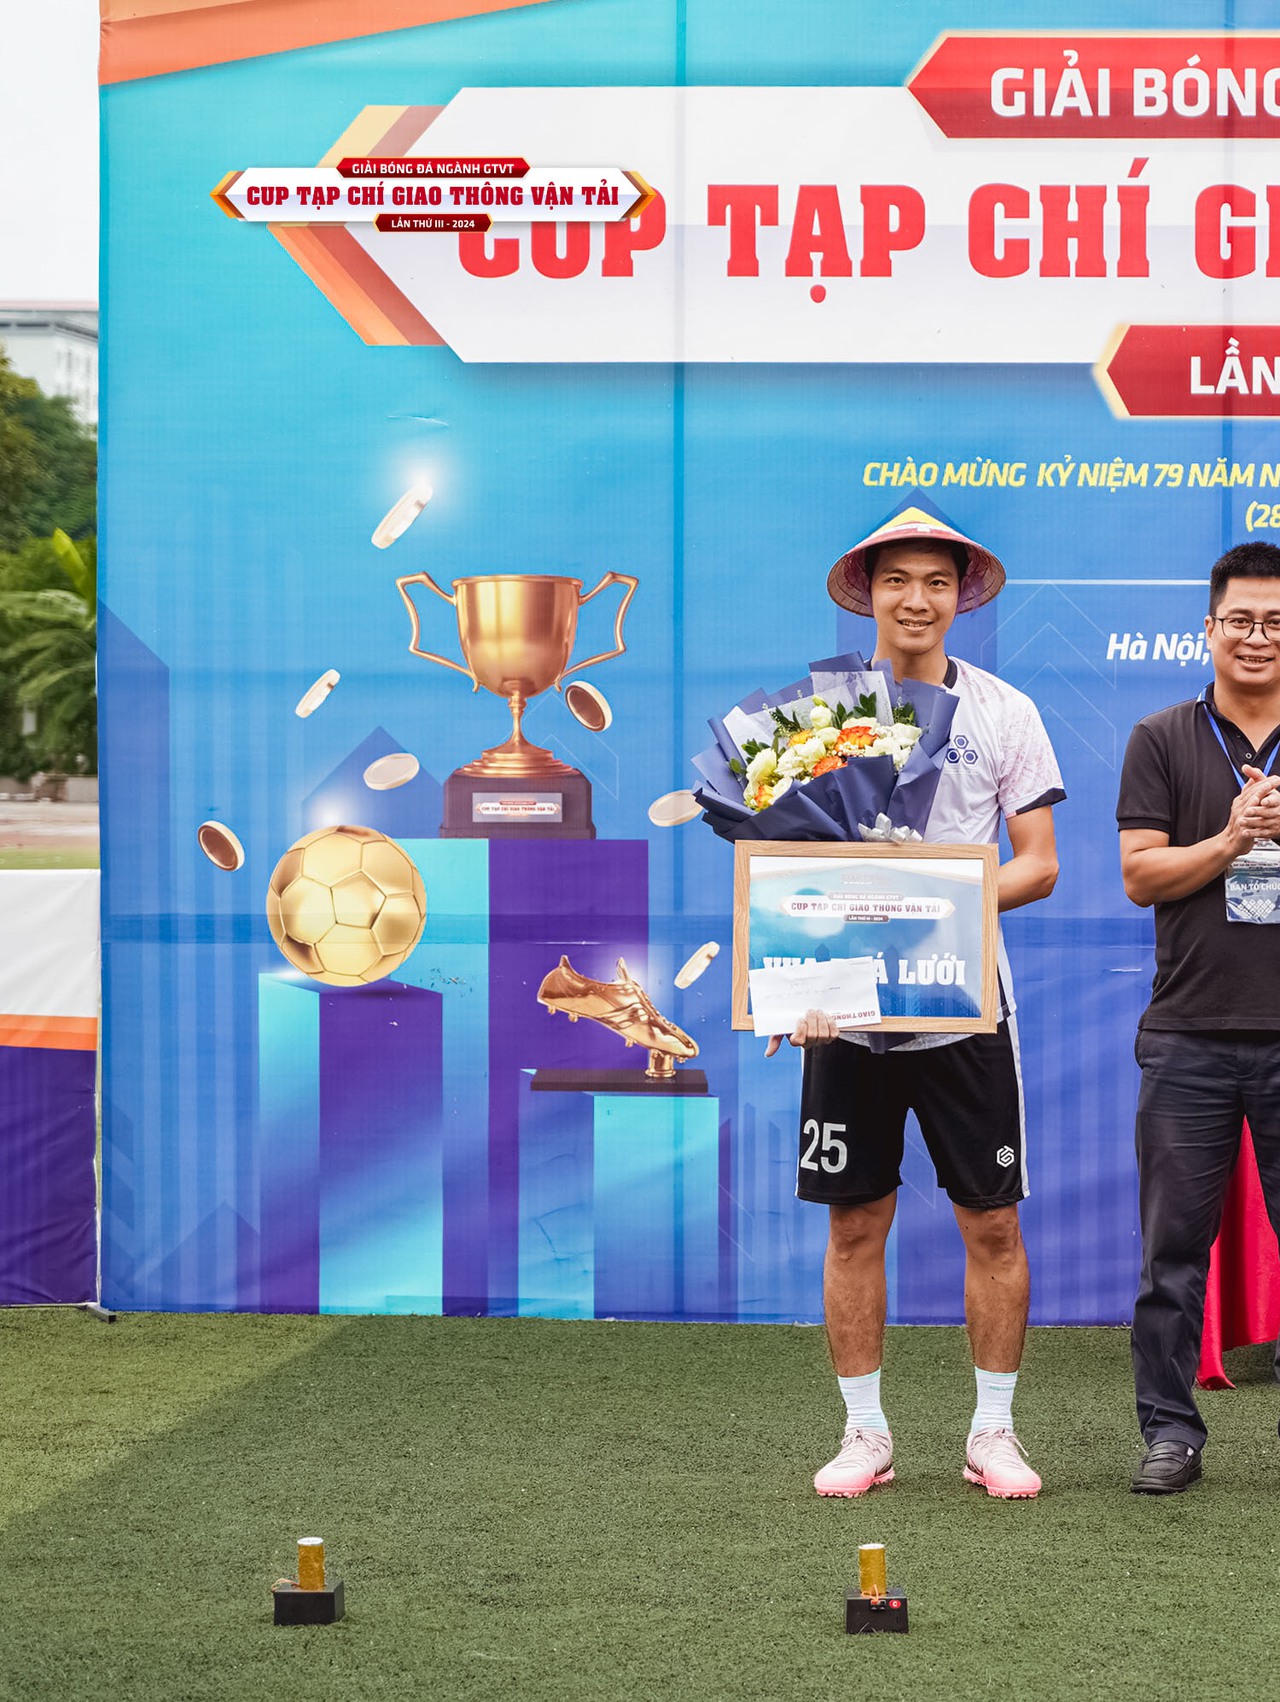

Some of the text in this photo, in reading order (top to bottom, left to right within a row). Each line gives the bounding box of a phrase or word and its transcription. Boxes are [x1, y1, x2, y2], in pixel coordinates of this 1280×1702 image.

[990, 48, 1110, 117] GIẢI
[458, 187, 666, 279] CUP
[706, 184, 926, 304] TẠP
[967, 157, 1150, 280] CHÍ
[862, 456, 939, 487] CHÀO
[941, 456, 1026, 487] MỪNG
[1036, 455, 1076, 487] KỶ
[1077, 456, 1149, 492] NIỆM
[1153, 464, 1183, 487] 79
[1188, 457, 1255, 488] NĂM
[1106, 632, 1148, 661] Hà
[1152, 630, 1211, 667] Nội,
[791, 902, 808, 911] CUP
[849, 903, 870, 912] GIAO
[897, 952, 966, 986] LƯỚI
[856, 1010, 876, 1018] GIAO
[800, 1118, 847, 1174] 25
